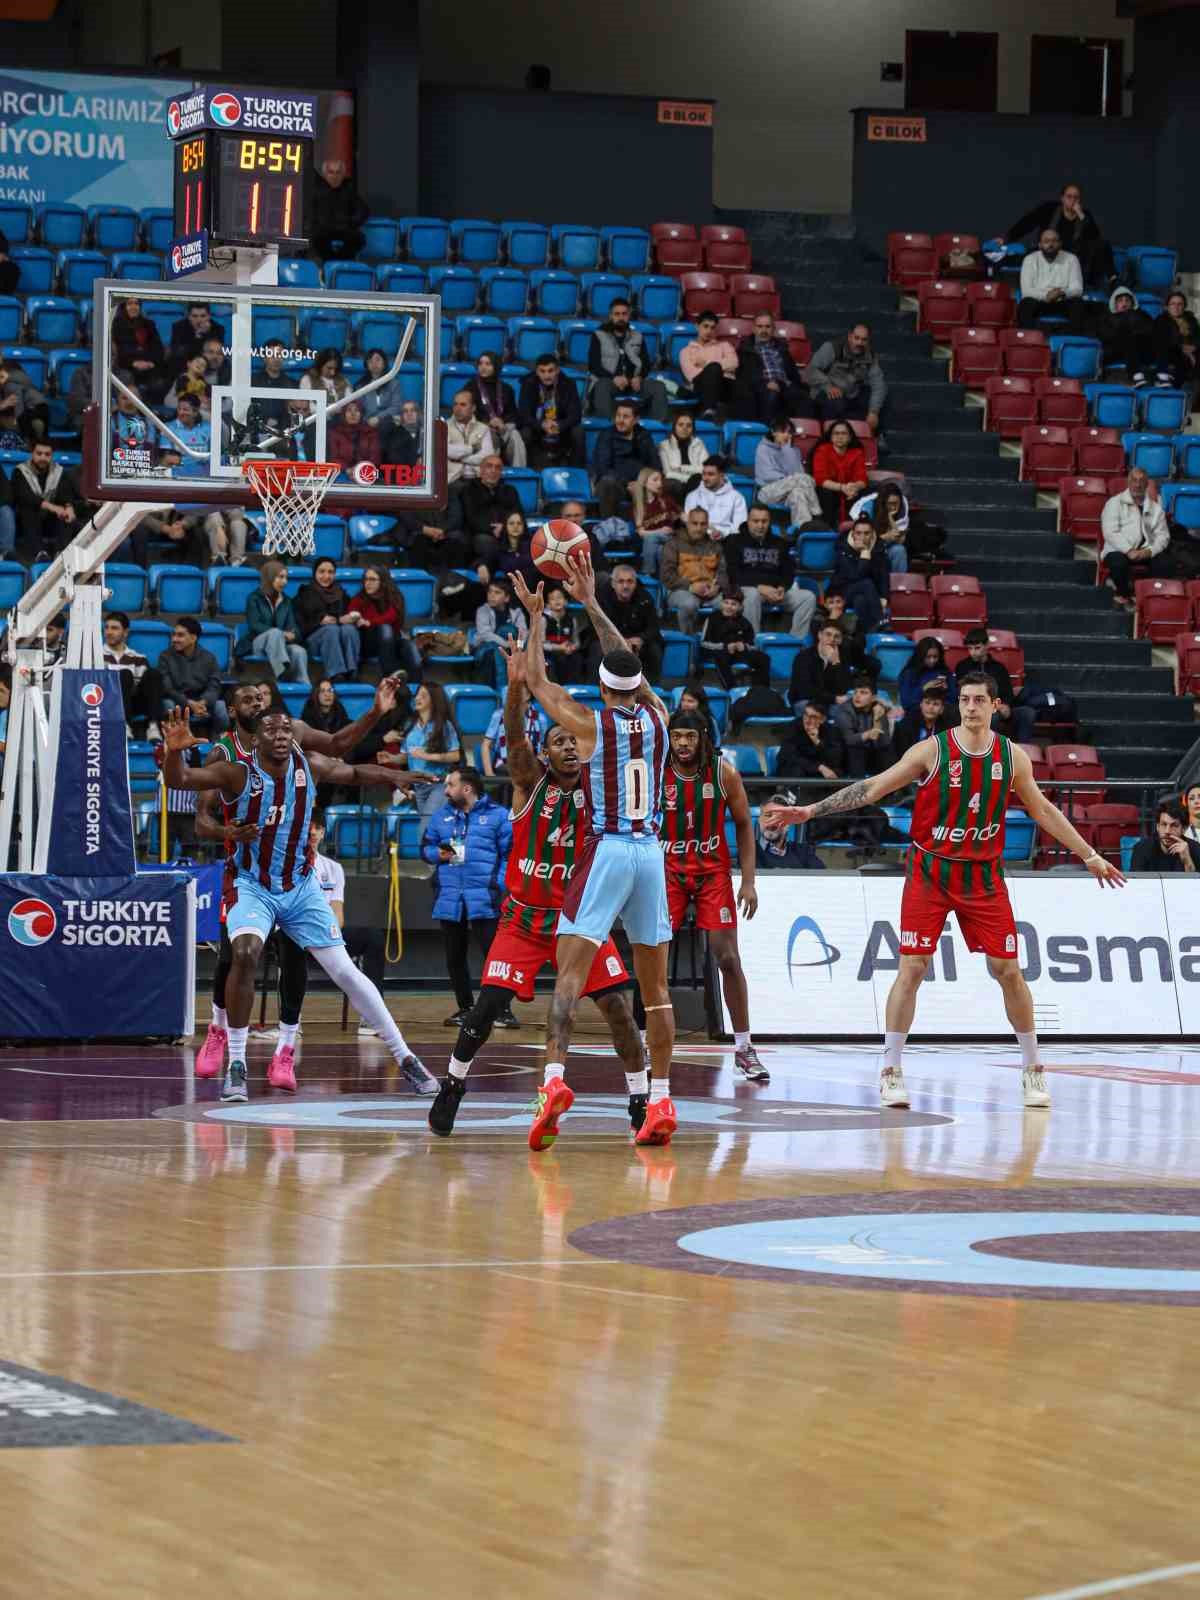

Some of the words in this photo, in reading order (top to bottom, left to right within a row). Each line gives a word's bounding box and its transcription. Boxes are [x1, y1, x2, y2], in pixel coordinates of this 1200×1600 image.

[0, 91, 163, 123] RCULARIMIZ
[885, 126, 923, 138] BLOK
[182, 139, 205, 173] 8:54
[239, 140, 301, 173] 8:54
[250, 182, 293, 236] 11
[624, 759, 649, 820] 0
[968, 792, 981, 814] 4
[265, 804, 287, 825] 31
[686, 811, 695, 829] 1
[547, 823, 575, 847] 42
